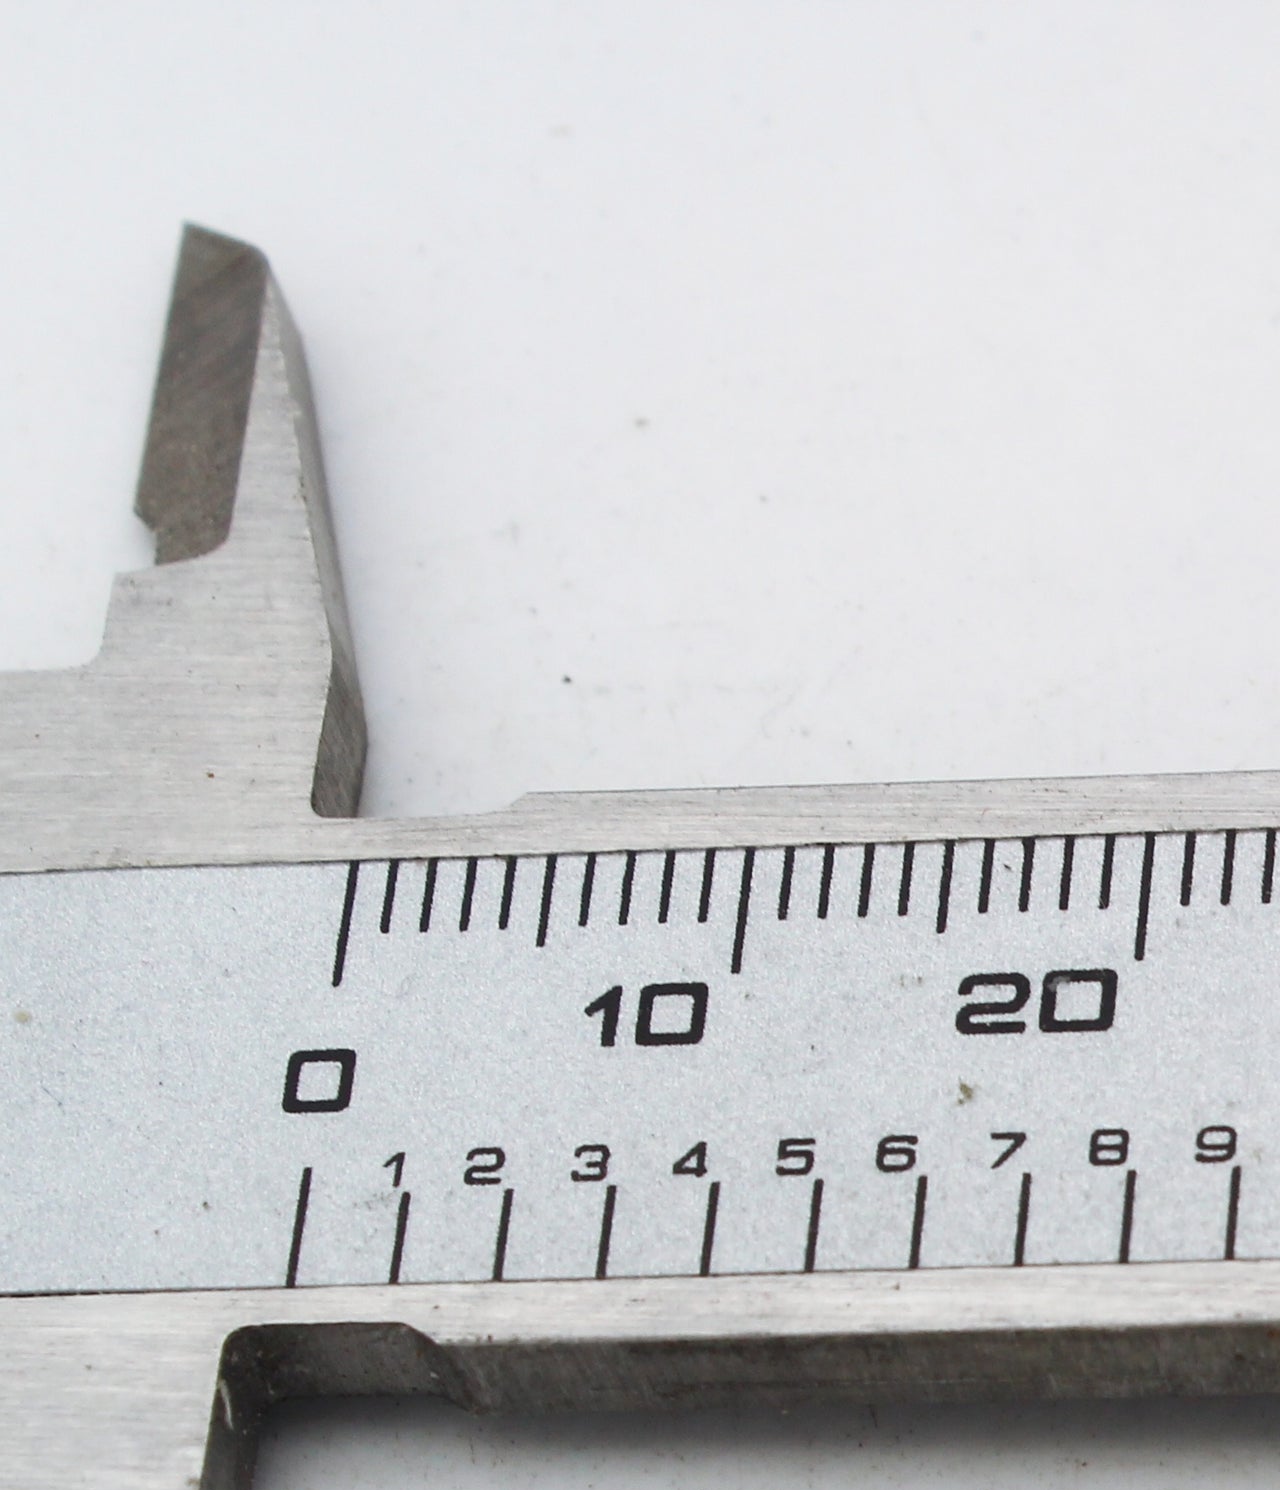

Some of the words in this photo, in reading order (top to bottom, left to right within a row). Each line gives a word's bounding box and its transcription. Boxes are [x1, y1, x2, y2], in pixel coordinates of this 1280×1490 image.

[281, 1048, 357, 1115] 0
[583, 980, 709, 1048] 10
[955, 968, 1119, 1037] 20
[383, 1151, 406, 1187] 1
[463, 1146, 506, 1185] 2
[570, 1144, 611, 1183] 3
[672, 1141, 708, 1178] 4
[775, 1137, 816, 1177] 5
[875, 1134, 919, 1174] 6
[989, 1131, 1027, 1169] 7
[1088, 1127, 1130, 1167] 8
[1194, 1125, 1238, 1164] 9
